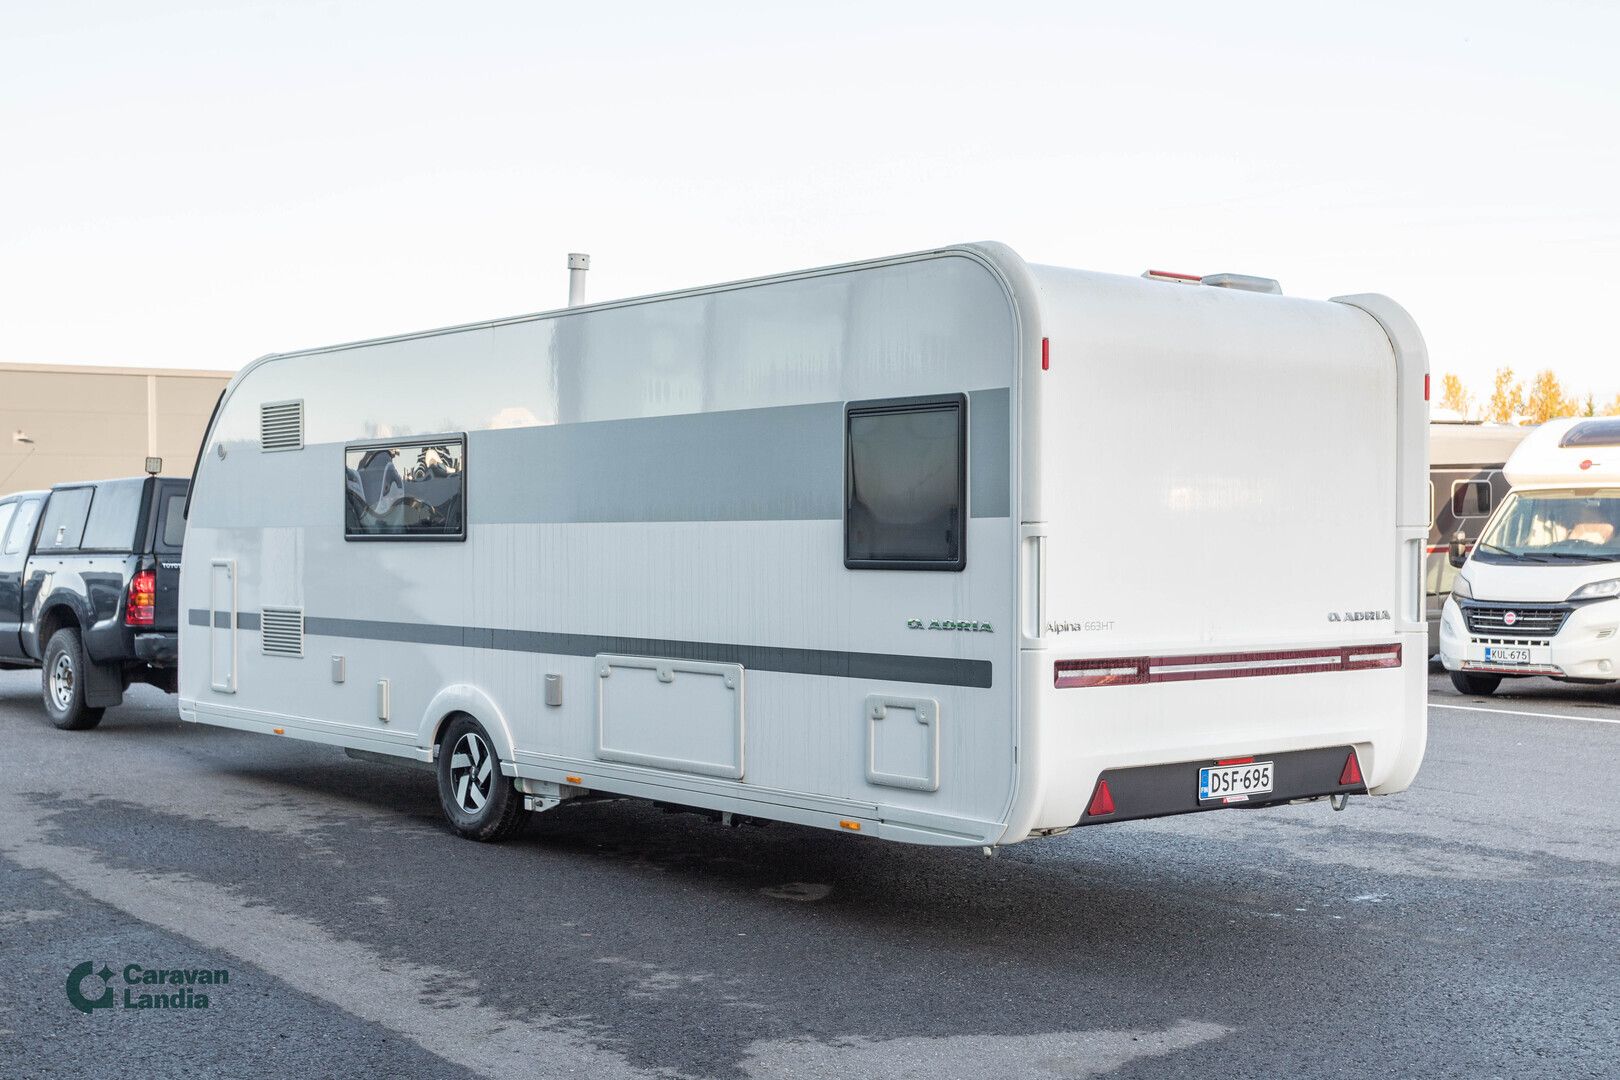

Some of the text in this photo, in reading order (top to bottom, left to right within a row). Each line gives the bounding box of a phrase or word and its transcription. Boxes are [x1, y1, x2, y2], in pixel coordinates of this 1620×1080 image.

[1343, 610, 1391, 621] ADRIA
[928, 619, 994, 633] ADRIA
[1046, 620, 1115, 635] Alpina 663HT
[1491, 650, 1528, 660] KUL-675
[1211, 767, 1269, 793] DSF-695
